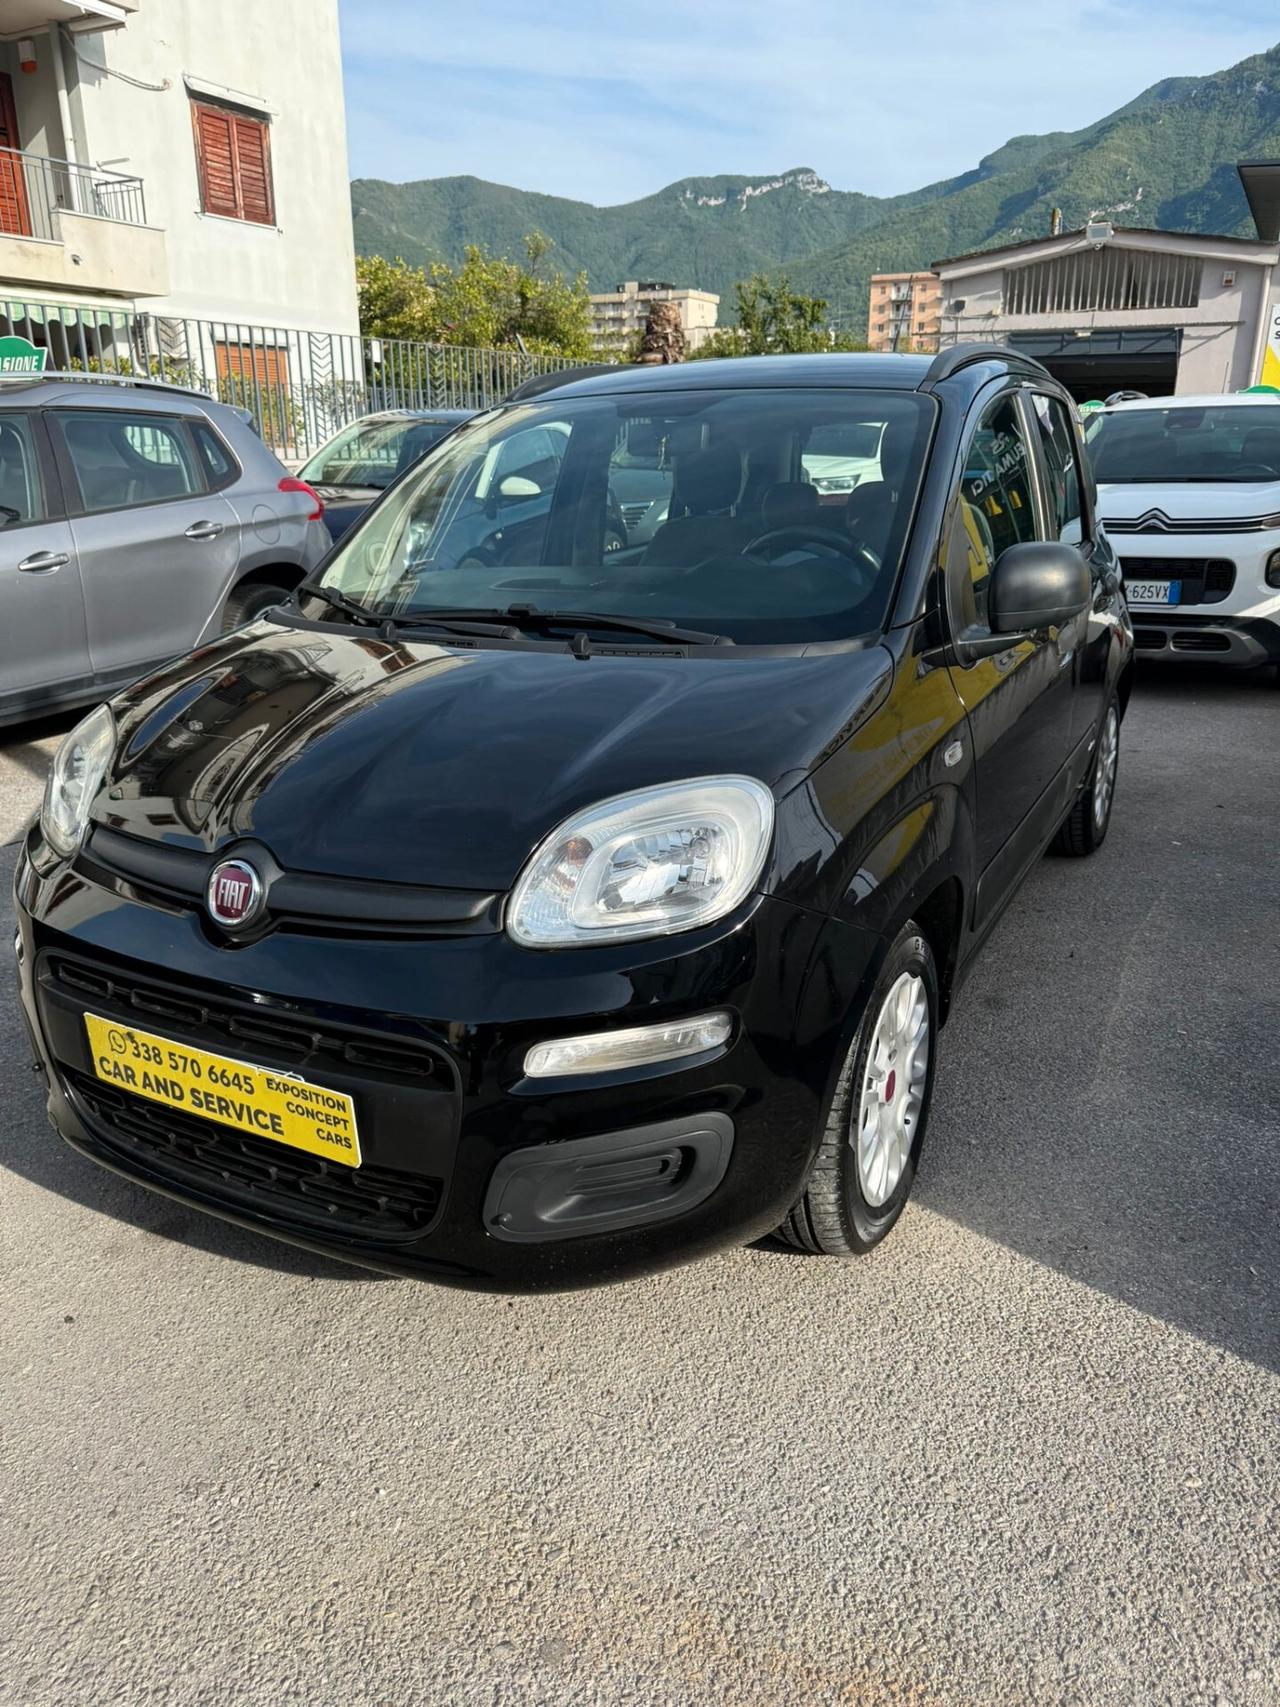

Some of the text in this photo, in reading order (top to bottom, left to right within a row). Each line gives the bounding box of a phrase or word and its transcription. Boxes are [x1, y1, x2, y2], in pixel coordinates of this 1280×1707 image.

[0, 356, 39, 371] SIONE
[216, 877, 249, 910] FIAT
[131, 1039, 255, 1096] 338 570 6645
[99, 1056, 285, 1136] CAR AND SERVICE
[266, 1078, 346, 1113] EXPOSITION
[286, 1101, 349, 1131] CONCEPT
[316, 1128, 353, 1149] CARS
